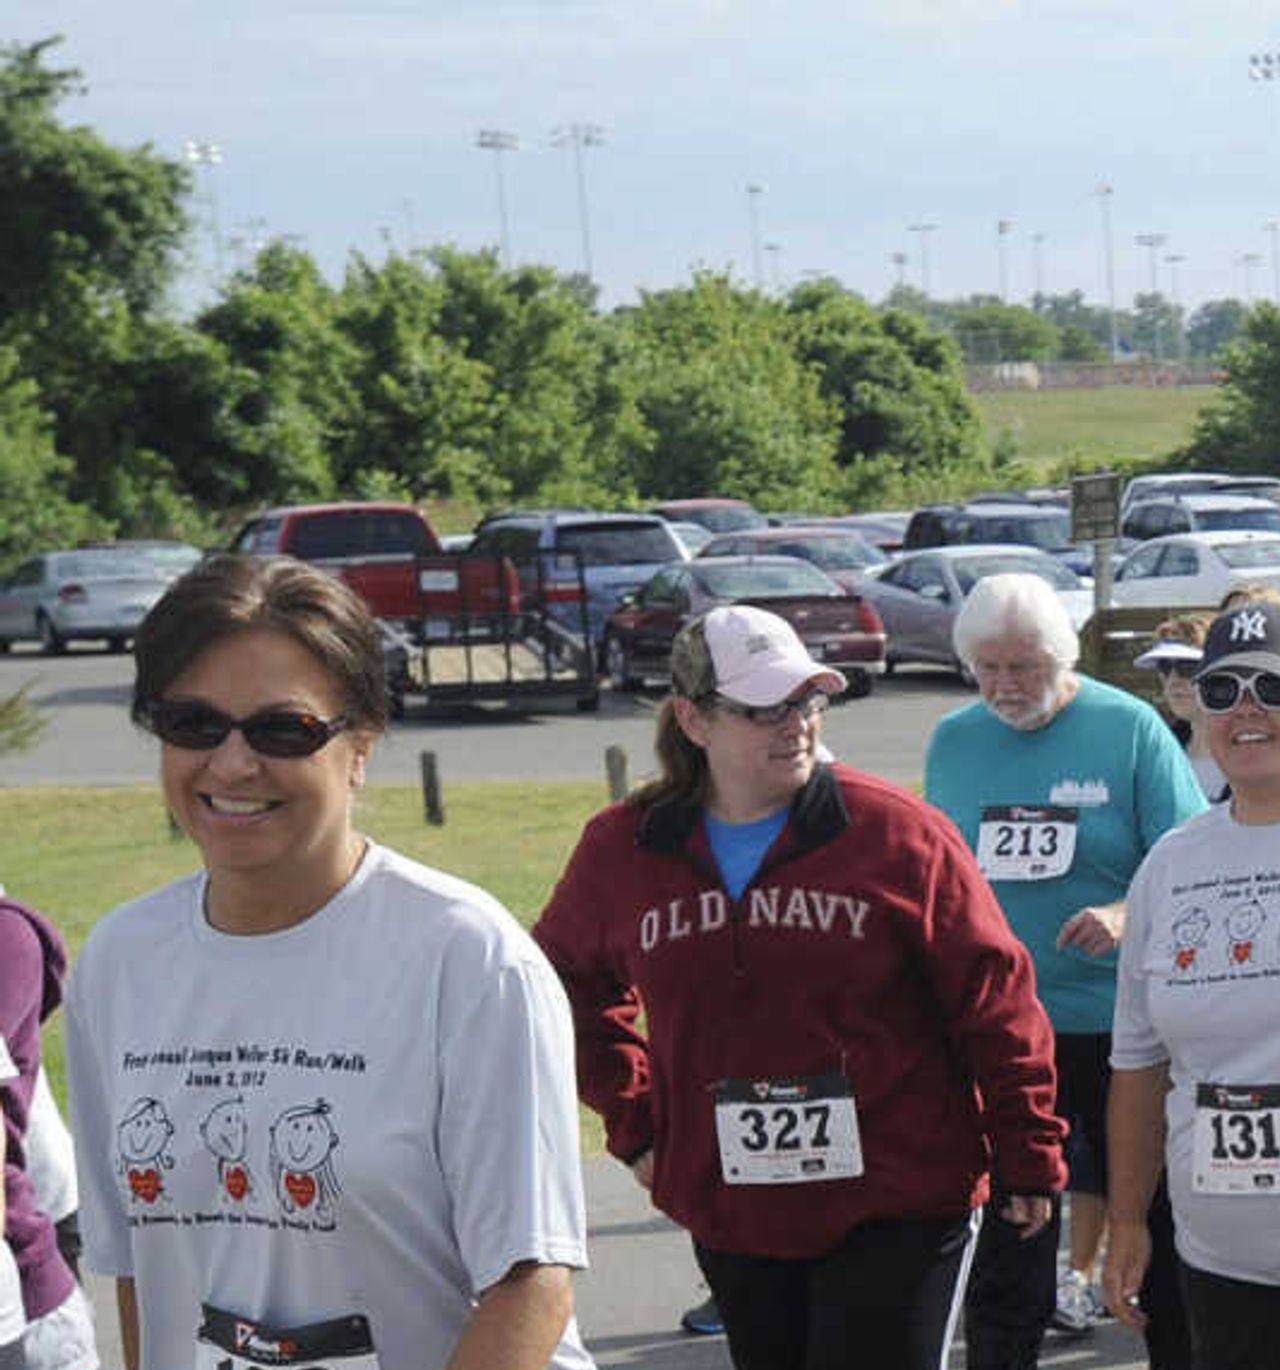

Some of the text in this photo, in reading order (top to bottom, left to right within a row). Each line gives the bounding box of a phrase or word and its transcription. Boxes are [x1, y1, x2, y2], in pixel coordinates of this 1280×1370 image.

[995, 826, 1058, 856] 213
[641, 887, 870, 951] OLD NAVY
[185, 1071, 222, 1088] June
[739, 1105, 830, 1151] 327
